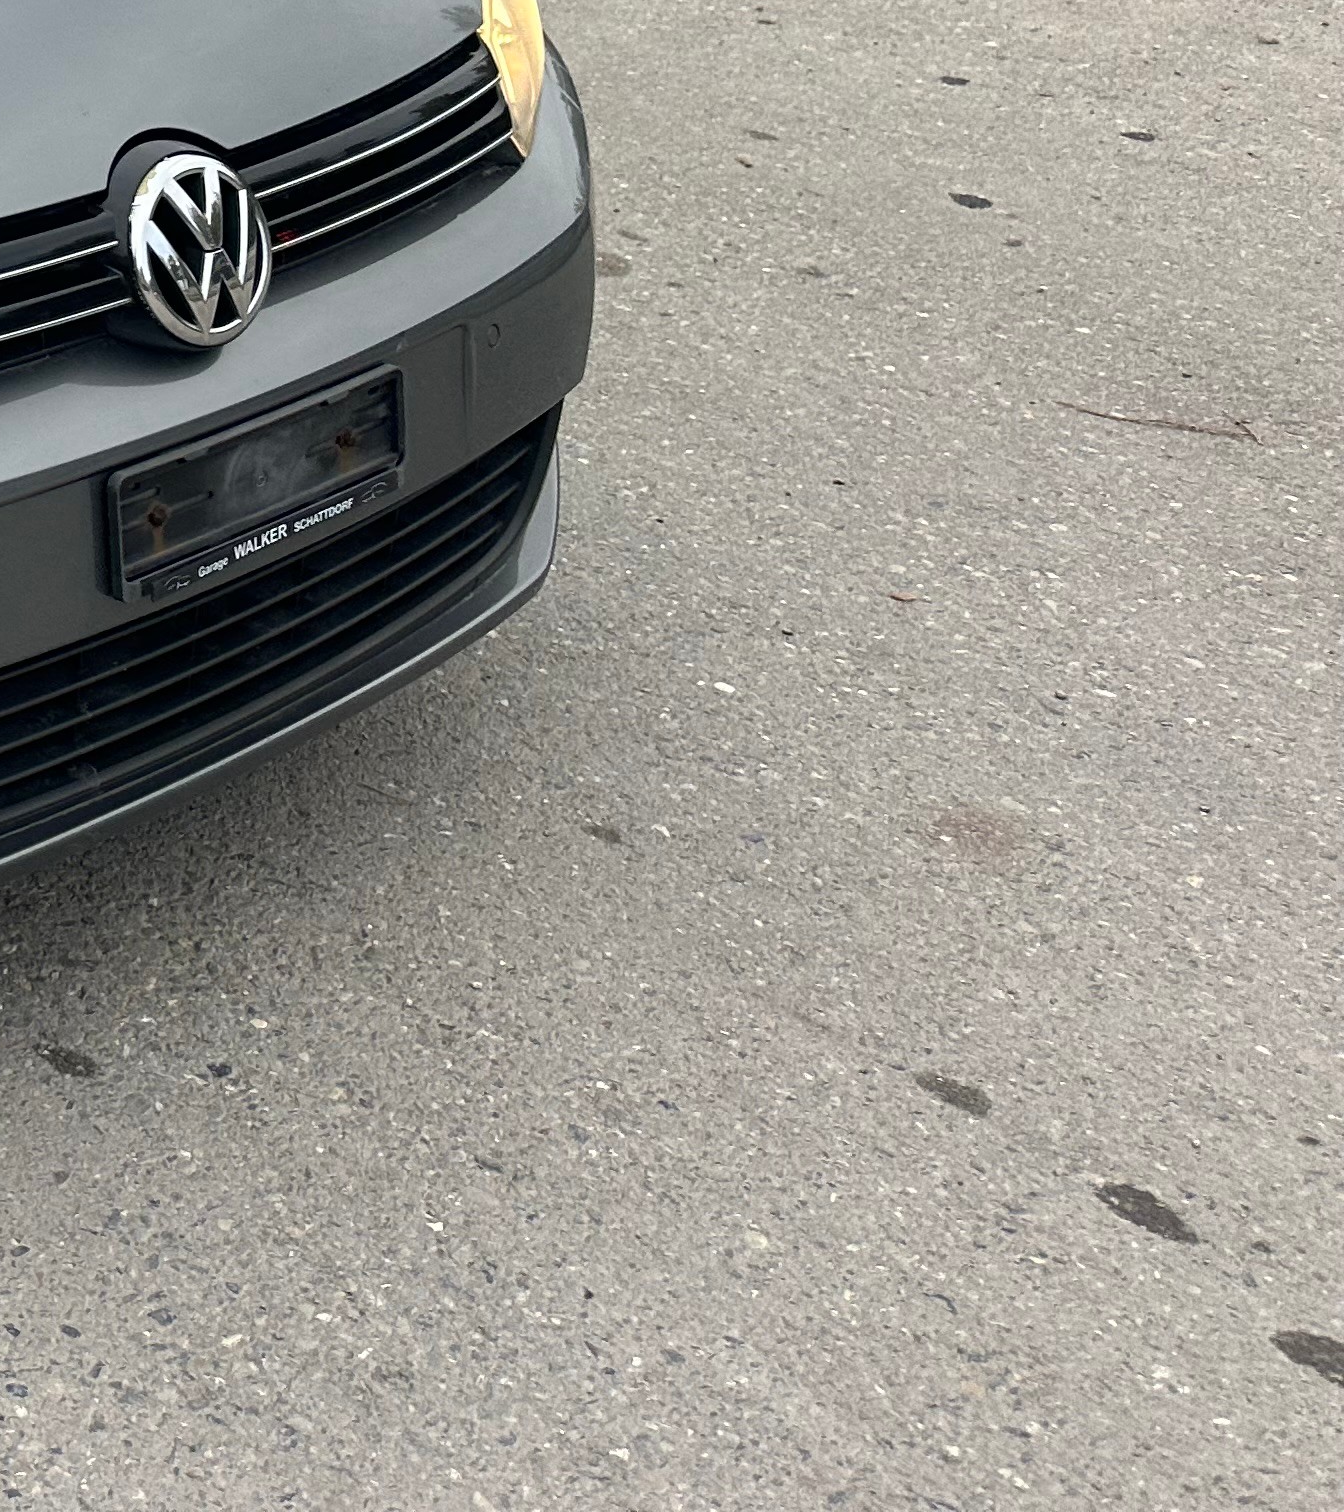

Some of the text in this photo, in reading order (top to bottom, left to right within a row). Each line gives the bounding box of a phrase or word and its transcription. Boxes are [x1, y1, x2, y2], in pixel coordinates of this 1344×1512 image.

[130, 154, 271, 346] VW
[198, 497, 355, 578] Garage WALKER SCHATTDORF
